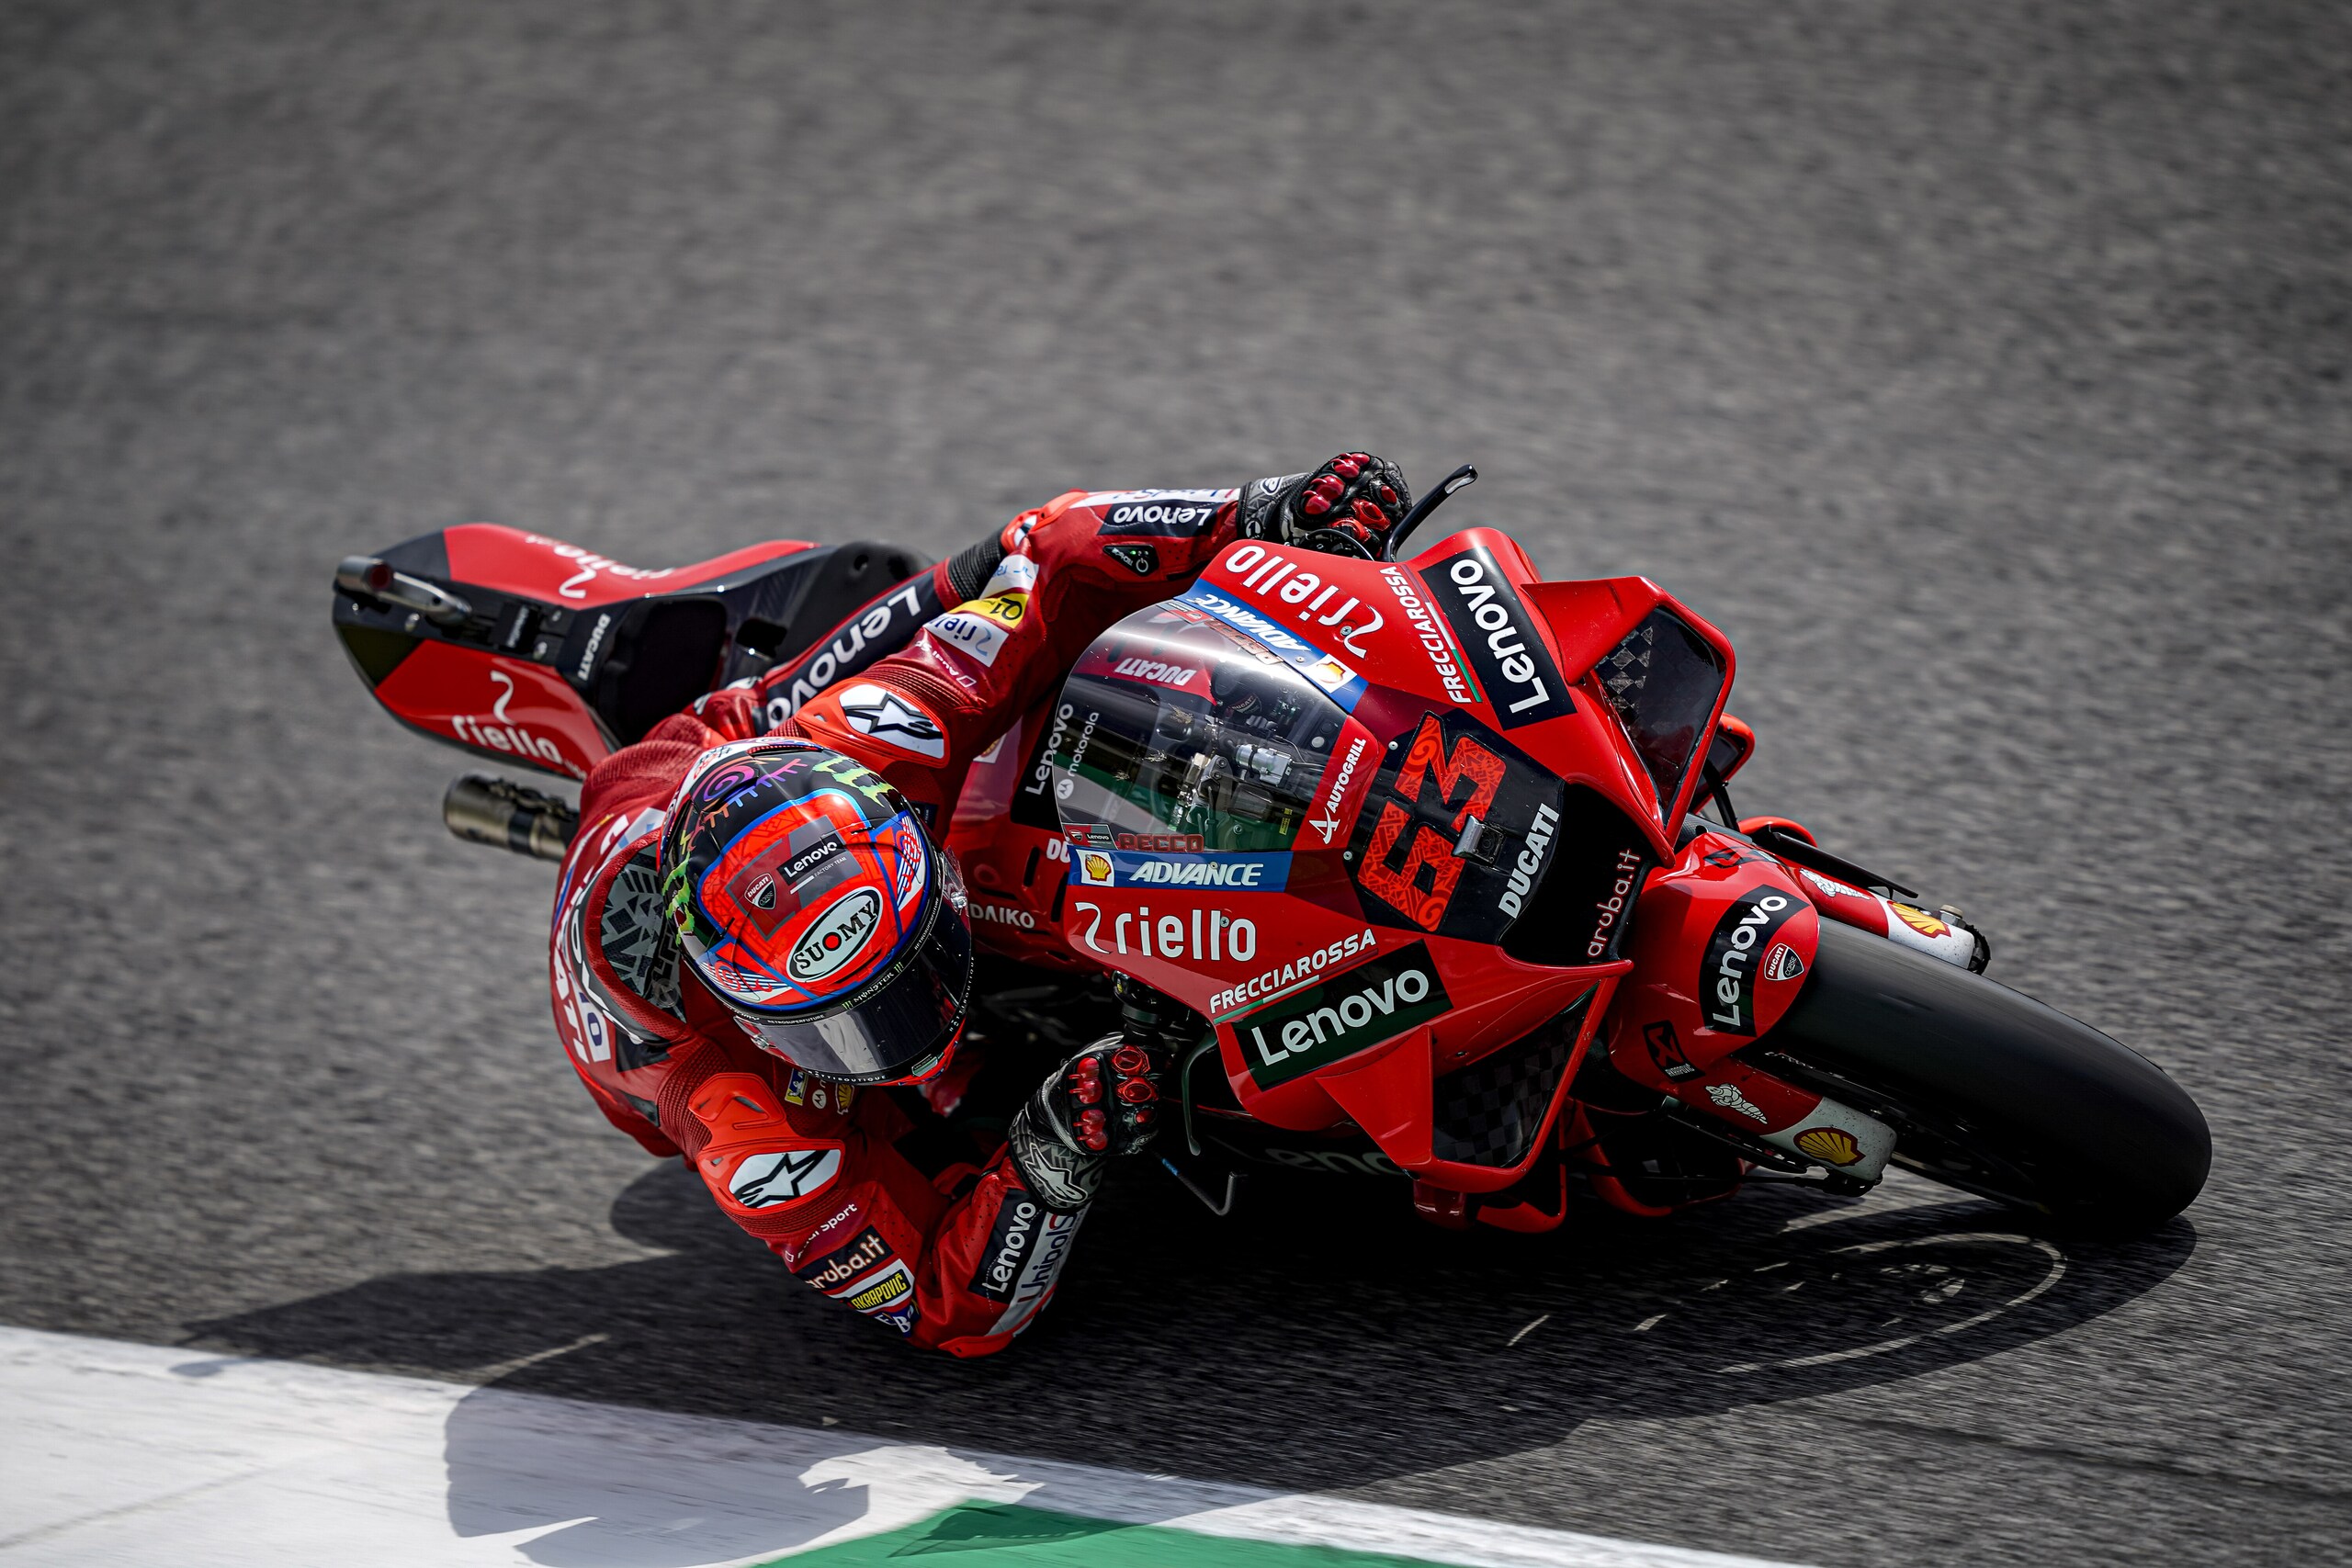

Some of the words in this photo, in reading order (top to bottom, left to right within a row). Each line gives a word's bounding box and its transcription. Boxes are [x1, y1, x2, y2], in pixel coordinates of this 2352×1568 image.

[1113, 504, 1213, 526] Lenovo
[1225, 545, 1361, 626] riello
[577, 613, 612, 681] DUCATI
[1186, 593, 1312, 652] ADVANCE
[1380, 566, 1473, 704] FRECCIAROSSA
[1450, 558, 1550, 714] Lenovo
[766, 585, 922, 730] Lenovo
[1114, 657, 1197, 686] DUCATI
[451, 715, 563, 765] riello
[1024, 703, 1074, 795] Lenovo
[1067, 711, 1100, 777] motorola
[1325, 738, 1367, 814] AUTOGRILL
[1358, 714, 1508, 932] 63
[747, 876, 769, 897] DUCATI
[783, 841, 838, 878] Lenovo
[813, 862, 835, 877] FACTORY
[833, 856, 847, 864] TEAM
[1128, 861, 1264, 886] ADVANCE
[1498, 803, 1560, 919] DUCATI
[794, 900, 877, 970] SUOMY
[968, 903, 1035, 929] DAIKO
[1114, 906, 1257, 962] riello
[1587, 848, 1642, 958] aruba.it
[853, 971, 895, 1004] MONSTER
[1209, 928, 1376, 1014] FRECCIAROSSA
[1713, 894, 1788, 1027] Lenovo
[1768, 946, 1784, 976] DUCATI
[1250, 969, 1430, 1067] Lenovo
[981, 1201, 1036, 1293] Lenovo
